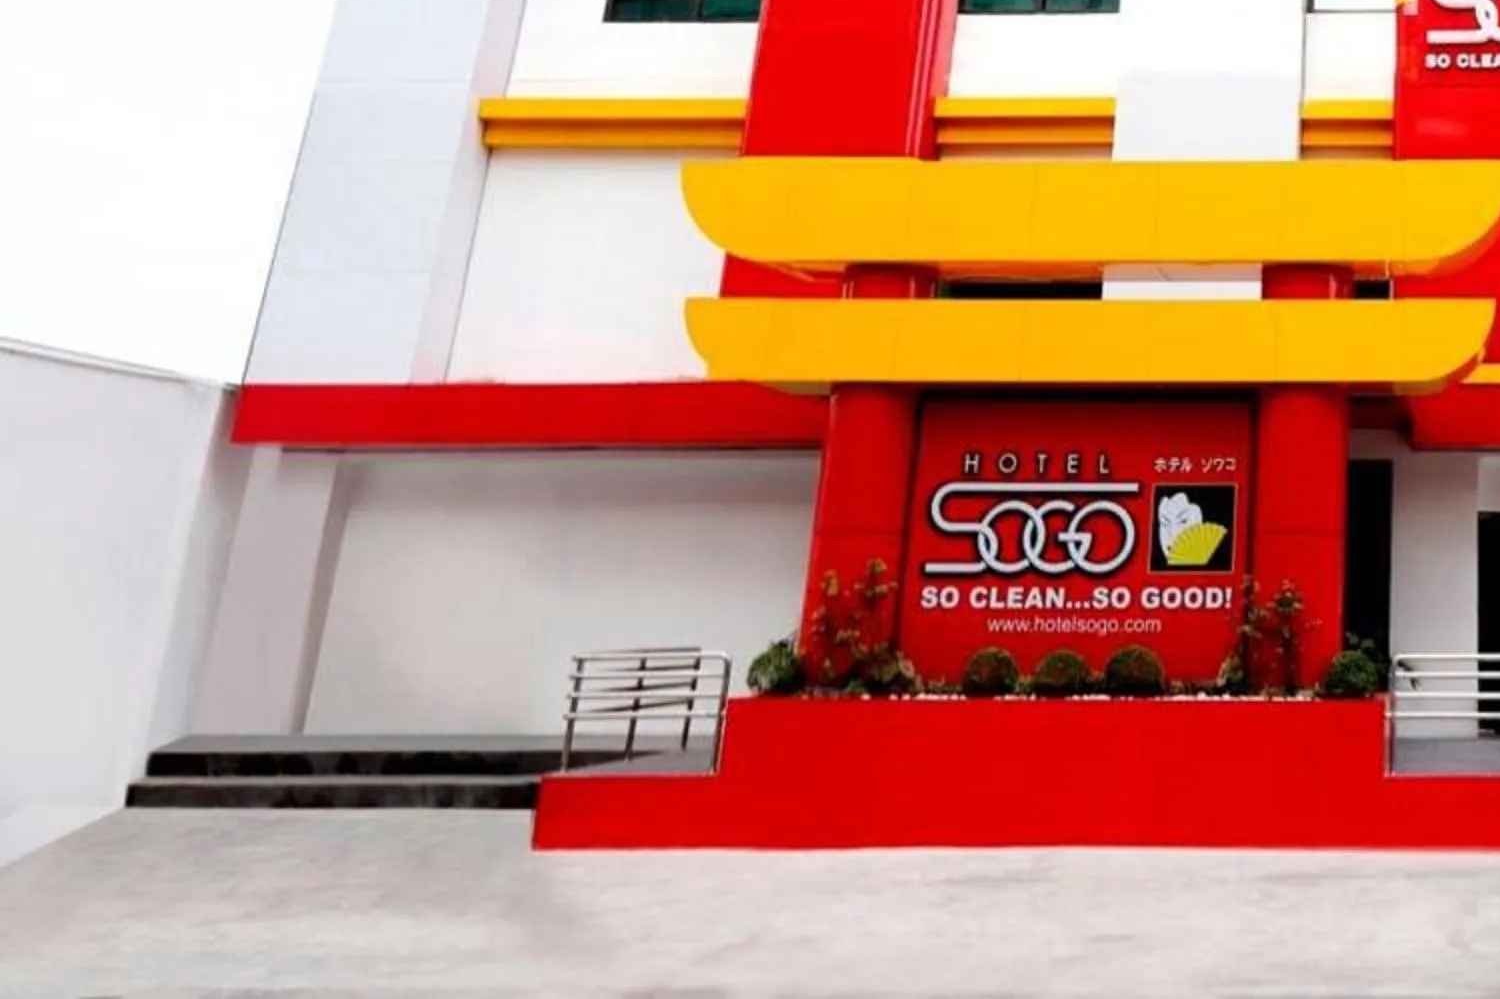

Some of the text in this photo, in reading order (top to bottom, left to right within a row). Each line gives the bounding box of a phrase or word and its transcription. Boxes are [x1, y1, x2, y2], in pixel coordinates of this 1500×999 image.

[1425, 54, 1449, 68] SO
[963, 454, 1111, 475] HOTEL
[924, 481, 1139, 574] SOGO
[921, 587, 961, 609] SO
[1141, 587, 1233, 609] GOOD!
[987, 617, 1162, 635] www.hotelsogo.com
